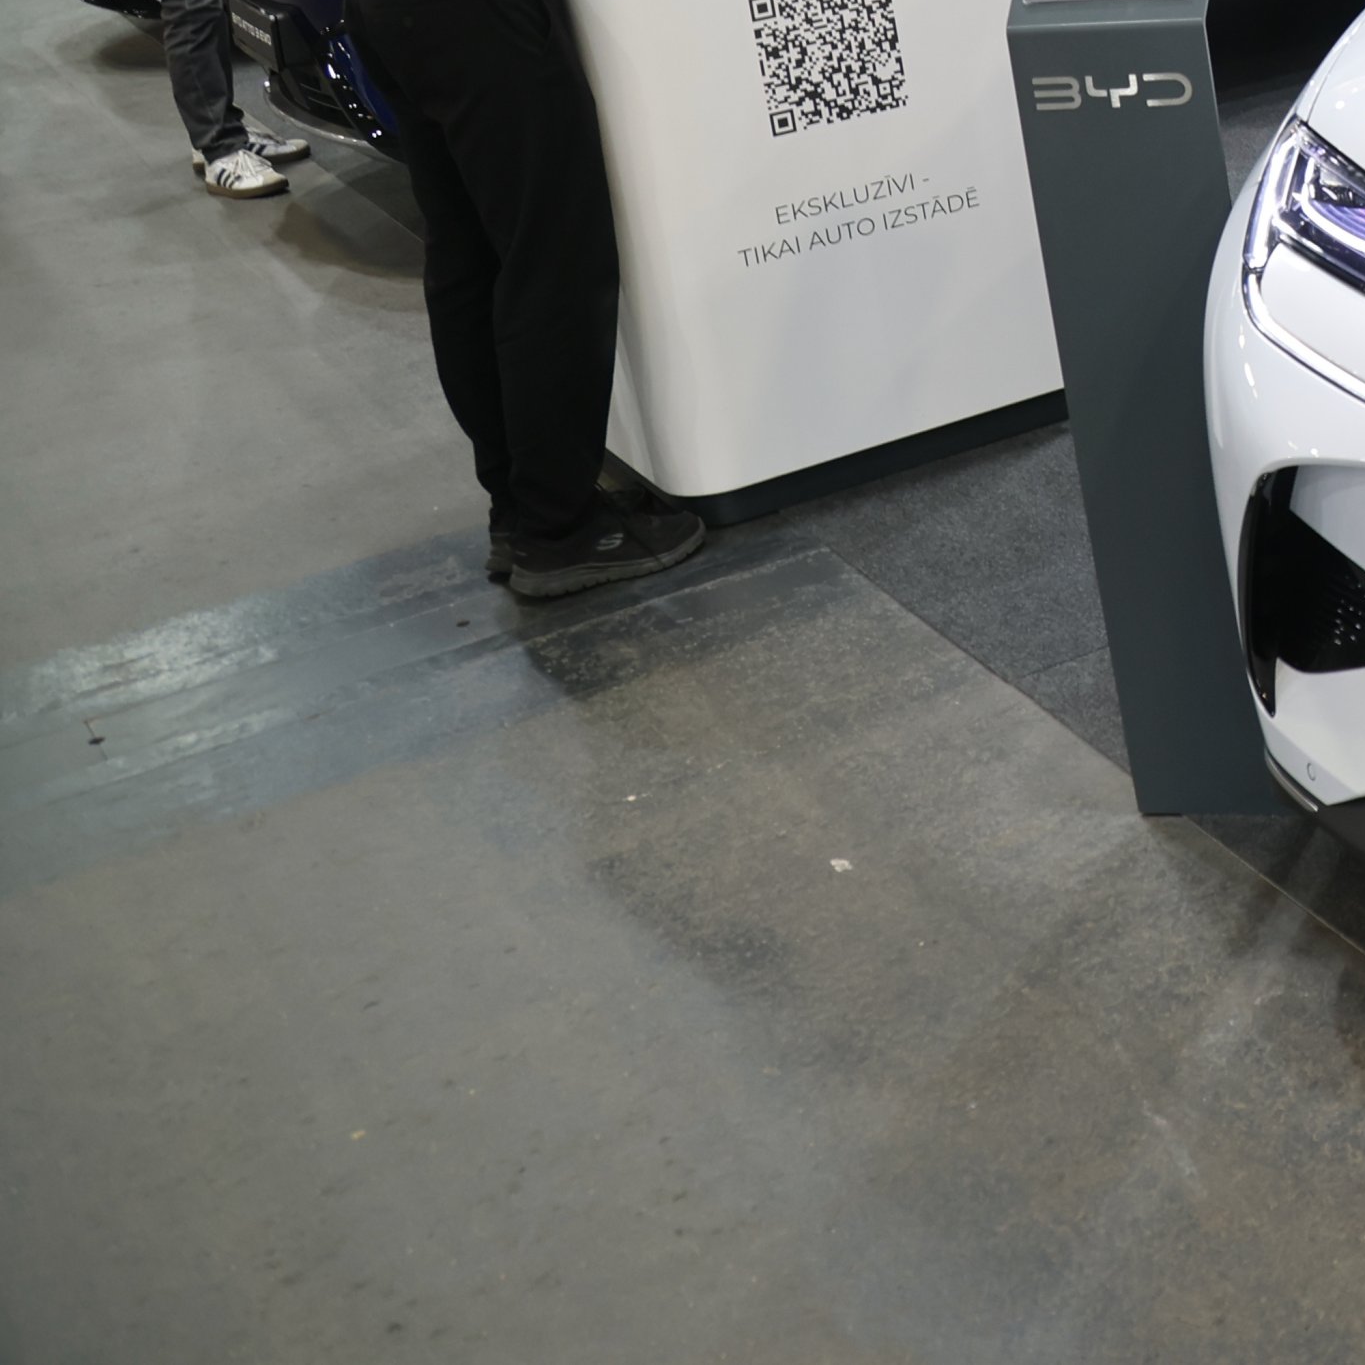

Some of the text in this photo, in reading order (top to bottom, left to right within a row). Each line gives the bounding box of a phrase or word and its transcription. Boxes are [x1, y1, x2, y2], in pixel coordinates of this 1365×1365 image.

[1032, 72, 1193, 111] BYD
[774, 173, 917, 225] EKSKLUZĪVI
[737, 186, 981, 269] TIKAI AUTO IZSTĀDĒ
